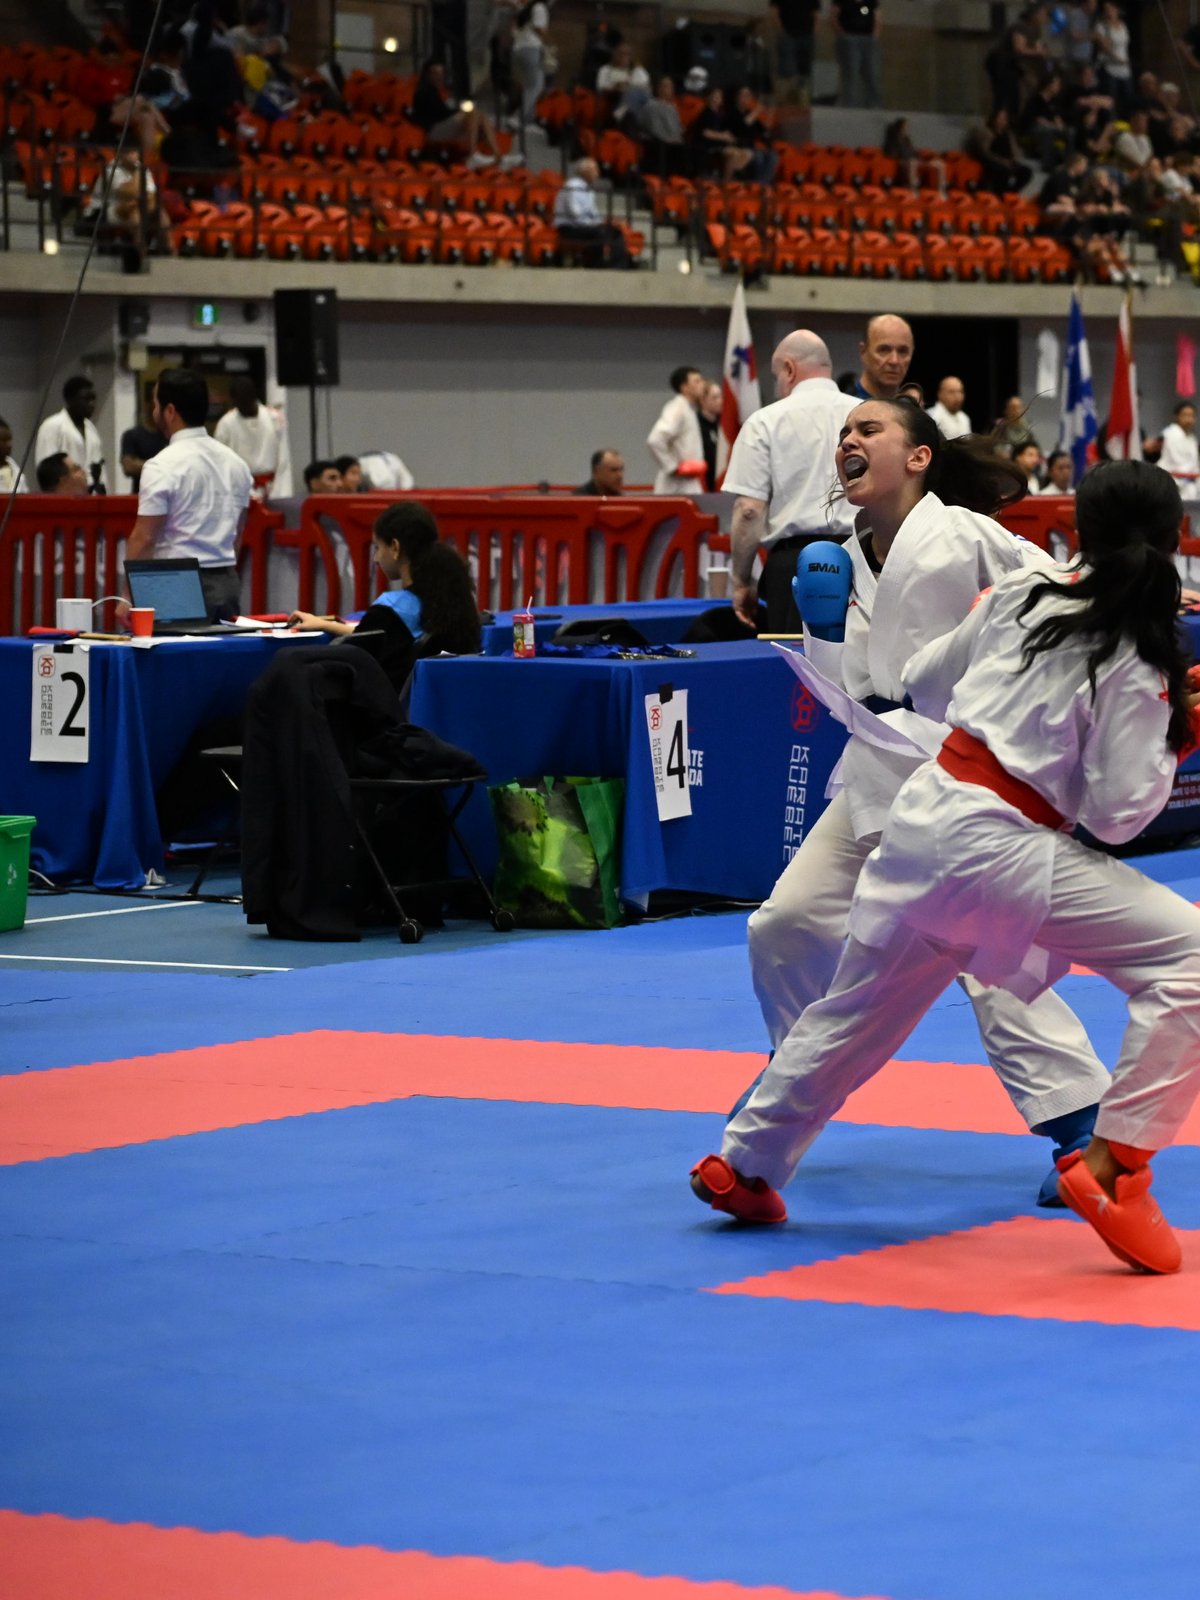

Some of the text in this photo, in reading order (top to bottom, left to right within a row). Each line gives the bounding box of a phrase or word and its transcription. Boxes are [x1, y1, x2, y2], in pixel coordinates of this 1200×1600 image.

[808, 562, 840, 574] SMAI
[59, 671, 86, 737] 2
[667, 719, 686, 789] 4
